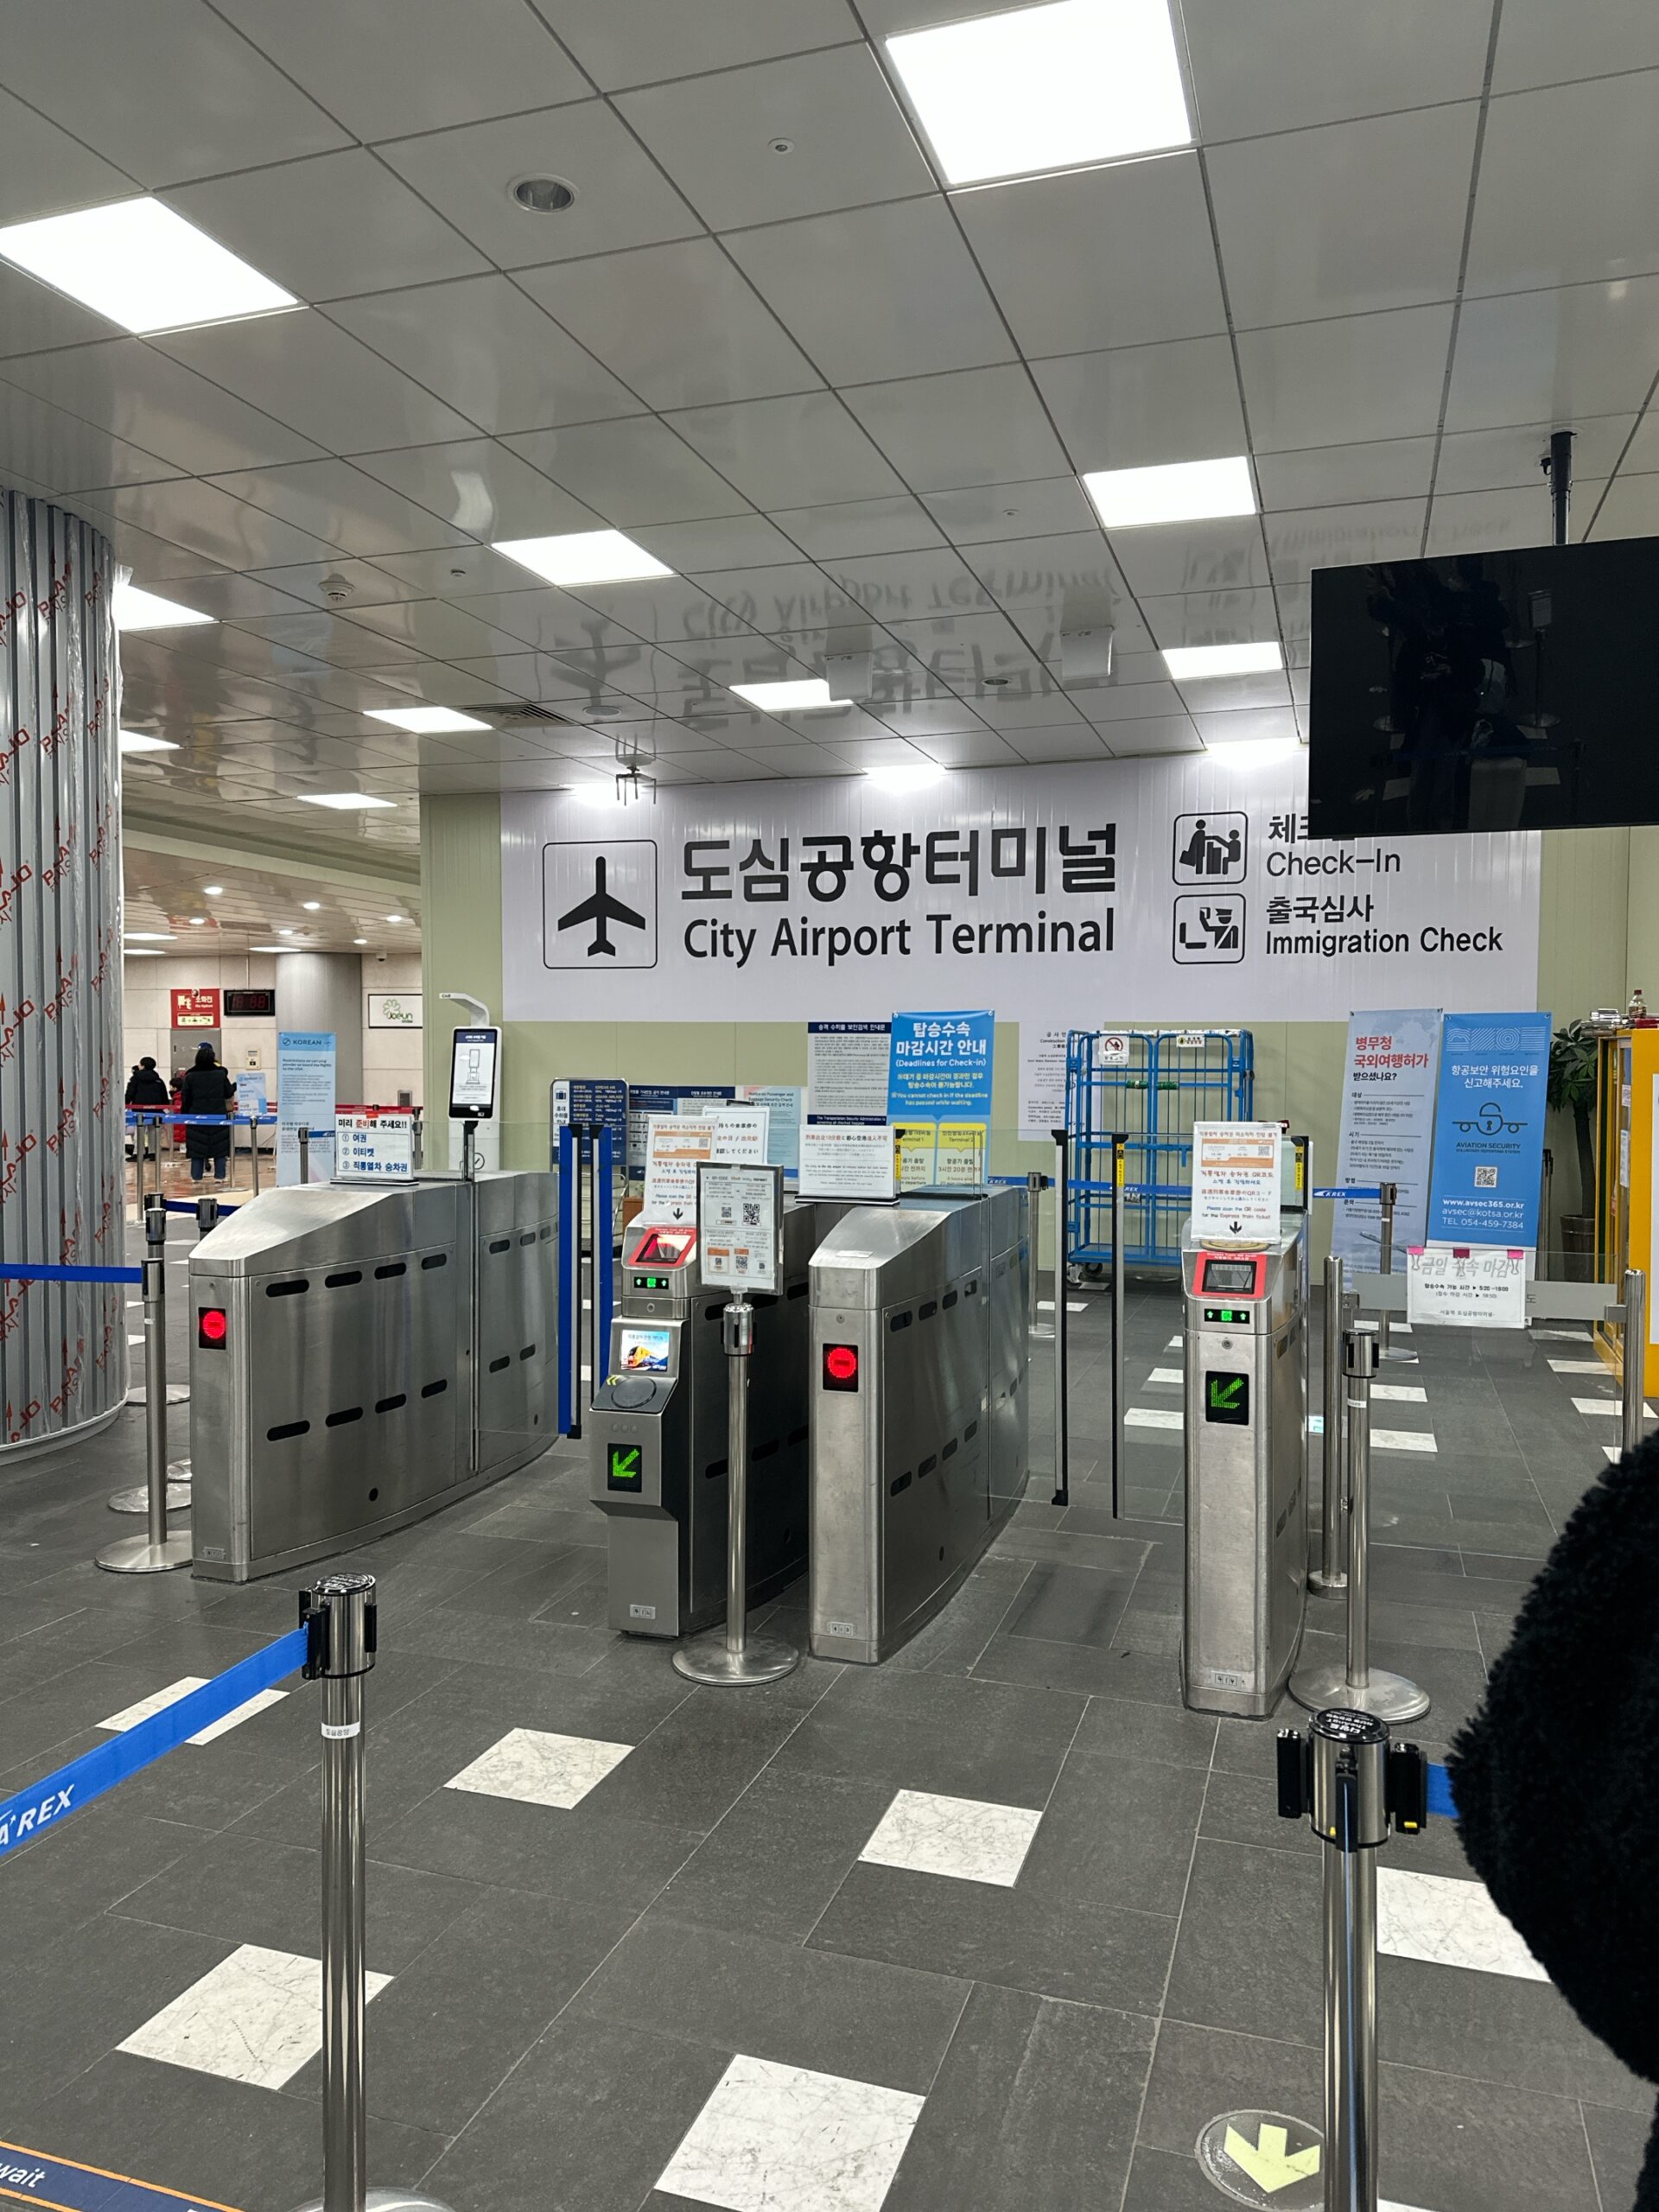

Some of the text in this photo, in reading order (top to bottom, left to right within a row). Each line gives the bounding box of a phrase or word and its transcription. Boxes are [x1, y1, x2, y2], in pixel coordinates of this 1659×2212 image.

[681, 823, 1116, 902] 도심공항터미널
[1267, 849, 1401, 877] Check-In
[1266, 894, 1374, 924] 출국심사
[683, 908, 1114, 969] City Airport Terminal
[1266, 925, 1503, 957] Immigration Check
[912, 1021, 970, 1038] 탑승수속
[896, 1040, 953, 1057] 마감시간
[957, 1039, 987, 1056] 안내
[1355, 1035, 1393, 1052] 병무청
[895, 1058, 935, 1067] (Deadlines
[949, 1058, 987, 1066] Check-in)
[1354, 1053, 1429, 1069] 국외여행허가
[1352, 1071, 1397, 1082] 받으셨나요?
[1451, 1065, 1540, 1077] 항공보안 위험요인을
[1464, 1077, 1524, 1090] 신고해주세요.
[338, 1119, 408, 1129] 미리 준비해 주세요!!
[353, 1134, 367, 1143] 여권
[353, 1147, 374, 1158] 이티켓
[353, 1160, 382, 1172] 직통열차
[385, 1161, 408, 1173] 승차권
[1442, 1198, 1525, 1210] www.avsec365.or.kr
[1441, 1207, 1524, 1219] avsec@kotsa.or.kr
[1442, 1217, 1524, 1230] TEL 054-459-7384
[1421, 1256, 1449, 1277] 금일
[1483, 1257, 1510, 1279] 마감
[325, 1726, 351, 1738] 도심공항
